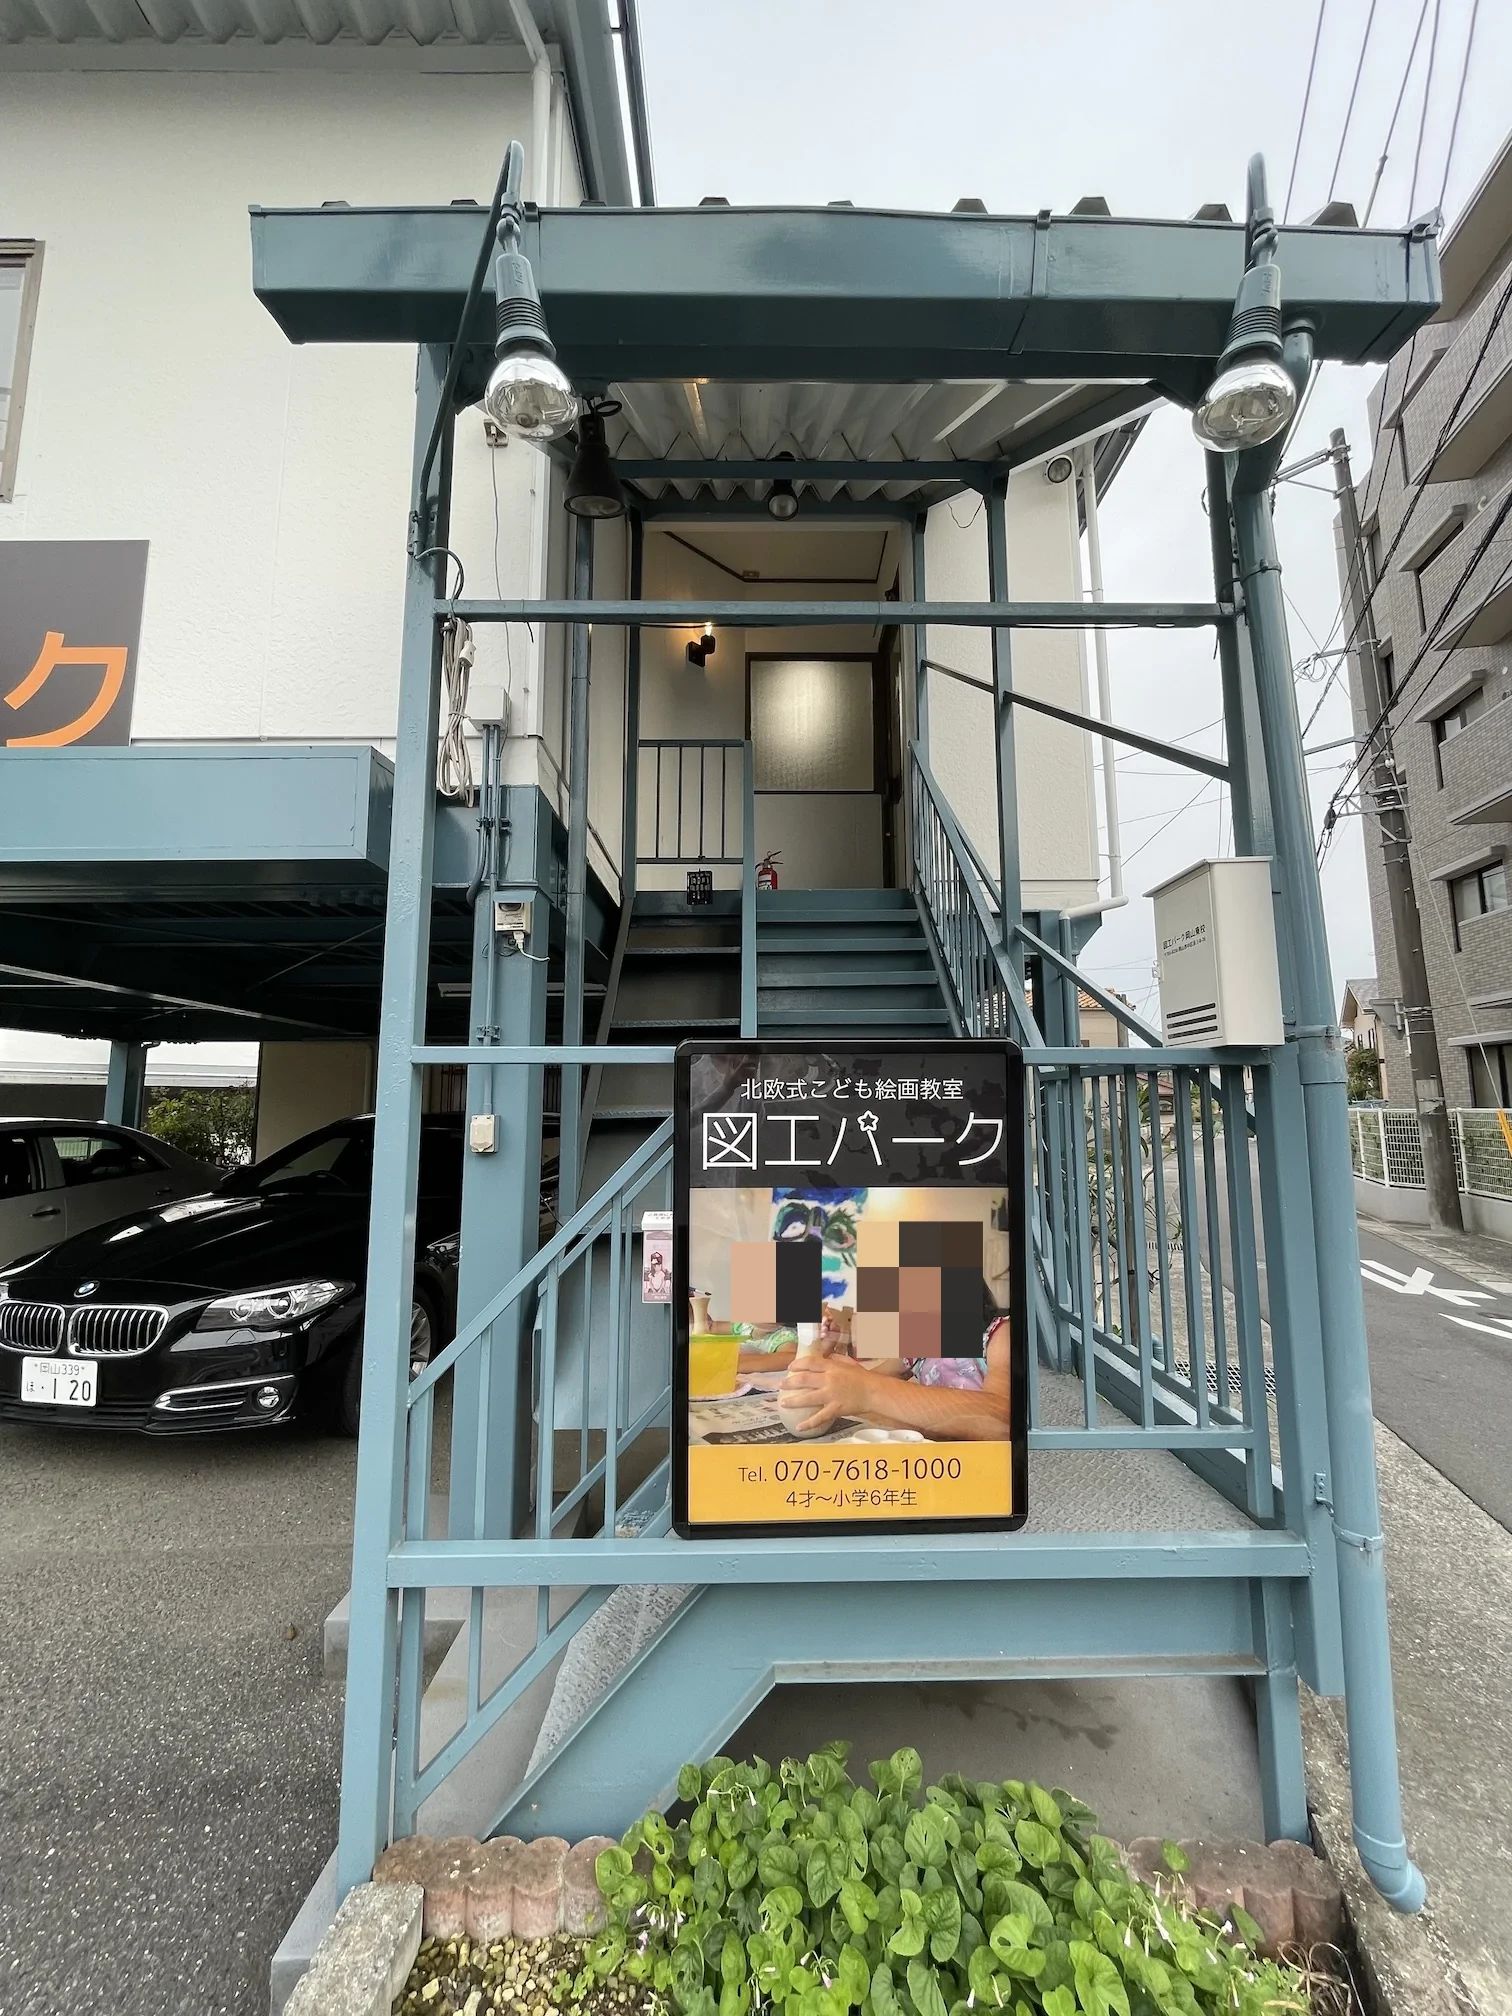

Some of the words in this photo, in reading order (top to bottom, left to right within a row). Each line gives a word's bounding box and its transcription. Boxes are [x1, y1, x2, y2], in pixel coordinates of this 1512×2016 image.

[4, 631, 128, 747] ク
[740, 1077, 964, 1101] 北欧式こども絵画教室
[702, 1110, 1004, 1171] 図工パーク
[738, 1466, 768, 1483] Tel.
[774, 1457, 962, 1482] 070-7618-1000
